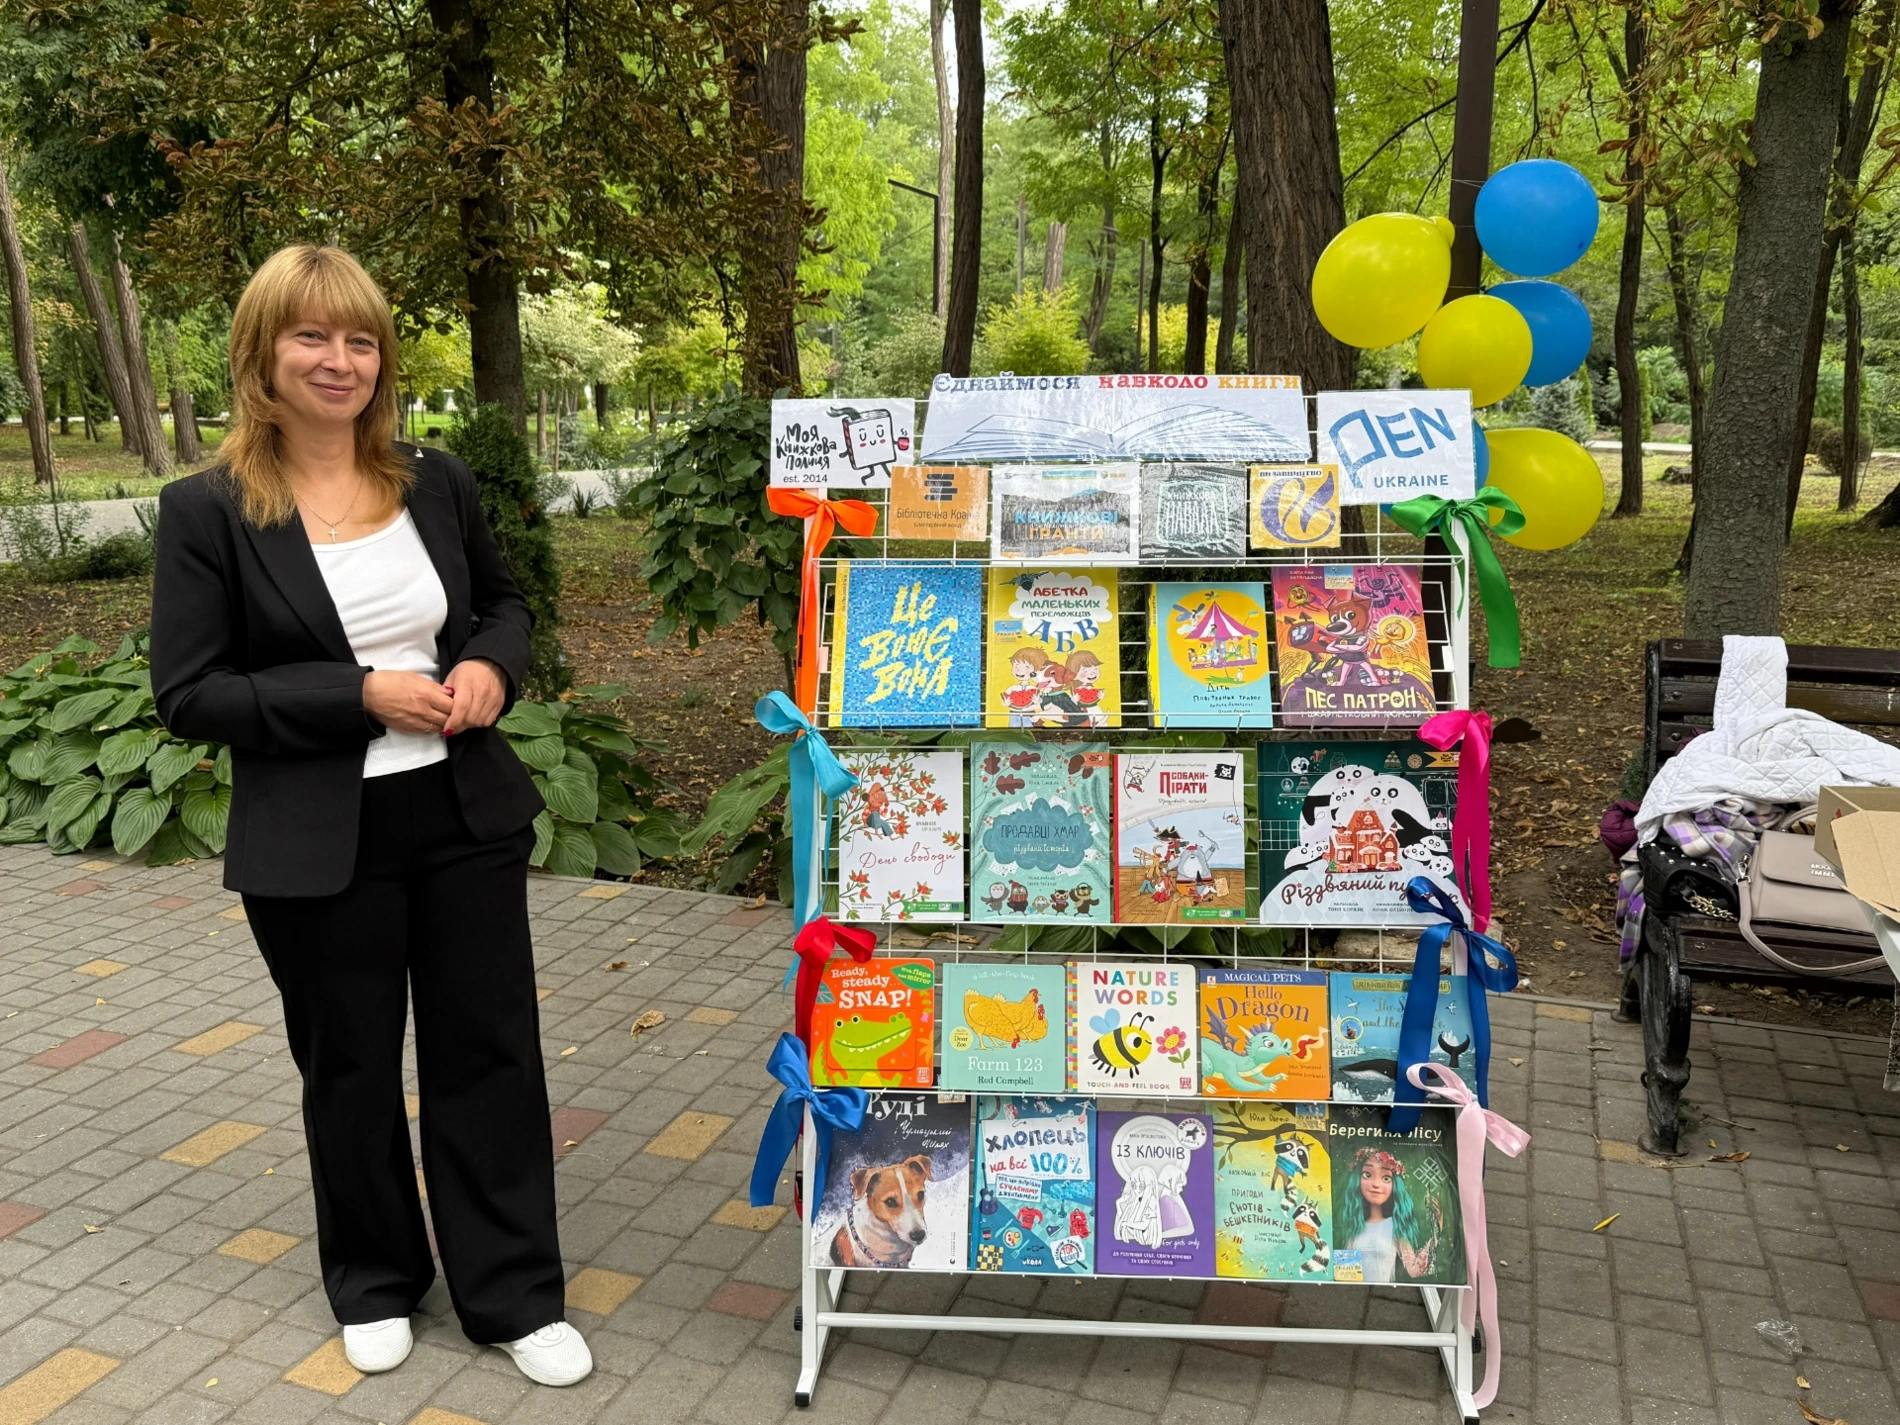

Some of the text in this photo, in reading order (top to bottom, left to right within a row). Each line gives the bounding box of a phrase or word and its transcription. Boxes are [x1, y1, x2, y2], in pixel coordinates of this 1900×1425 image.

[934, 372, 1299, 393] Єднаймося навколо книги
[786, 423, 819, 443] Моя
[776, 435, 837, 459] Книжкова
[1329, 407, 1456, 488] PEN
[786, 455, 830, 470] Полиця
[783, 474, 828, 483] est. 2014
[1374, 475, 1448, 488] UKRAINE
[897, 508, 947, 519] Бібліотечна
[1014, 511, 1119, 524] КНИЖКОВІ
[1029, 527, 1103, 539] ГРАНТИ
[1033, 587, 1088, 596] АБЕТКА
[891, 581, 937, 627] Це
[1021, 600, 1100, 608] МАЛЕНЬКИХ
[1305, 686, 1416, 709] ПЕС ПАТРОН
[1001, 824, 1079, 839] ПРОДАВЦІ ХМАР
[859, 842, 955, 875] День свободи
[1281, 874, 1386, 906] Різдвяний
[831, 967, 868, 978] Ready,
[1093, 970, 1179, 986] NATURE
[1224, 972, 1302, 983] MAGICAL PETS
[839, 989, 912, 1009] SNAP!
[1094, 989, 1178, 1006] WORDS
[1245, 985, 1282, 1000] Hello
[1215, 996, 1309, 1022] Dragon
[1362, 1016, 1380, 1027] and
[967, 1057, 1043, 1072] Farm 123
[978, 1076, 1034, 1086] Rod Campbell
[1117, 1145, 1185, 1159] 13 КЛЮЧІВ
[990, 1152, 1083, 1175] на всі 100%
[999, 1182, 1039, 1194] СУЧАСНОМУ
[1232, 1189, 1263, 1198] ПРИГОДИ
[1223, 1214, 1291, 1231] БЕШКЕТНИКІВ
[1062, 1245, 1074, 1254] TOP
